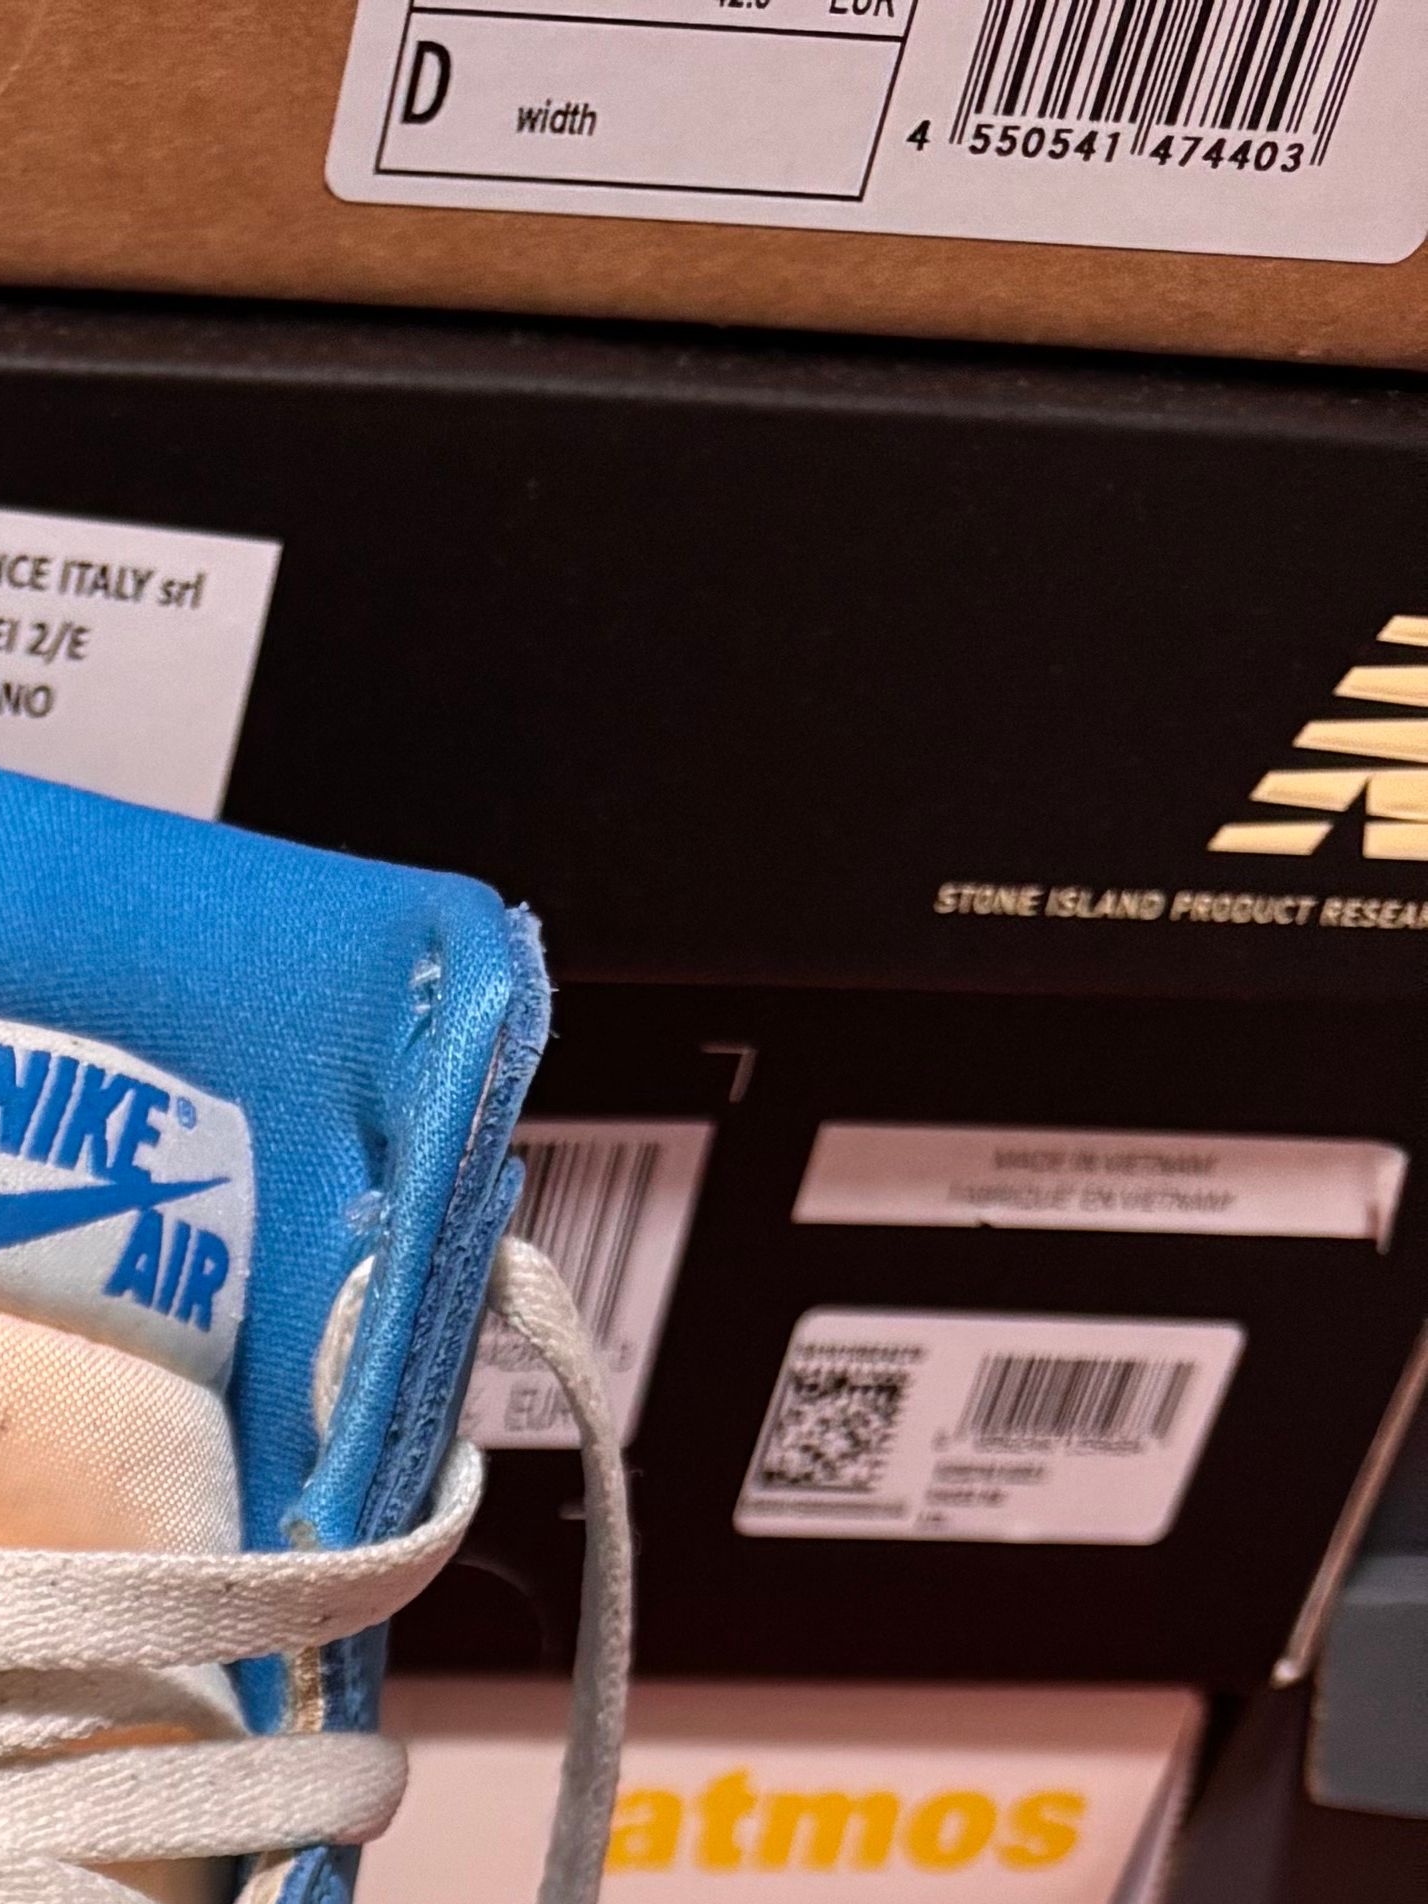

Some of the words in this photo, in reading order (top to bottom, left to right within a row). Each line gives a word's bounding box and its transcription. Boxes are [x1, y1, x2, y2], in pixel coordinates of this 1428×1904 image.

[400, 39, 453, 126] D
[515, 98, 598, 138] width
[907, 121, 933, 153] 4
[968, 120, 1122, 166] 550541
[1149, 134, 1306, 175] 474403
[59, 558, 149, 606] ITALY
[156, 572, 206, 611] srl
[24, 620, 90, 664] 2/E
[1169, 889, 1317, 925] PRODUCT
[105, 1207, 230, 1332] AIR
[603, 1765, 1087, 1873] atmos
